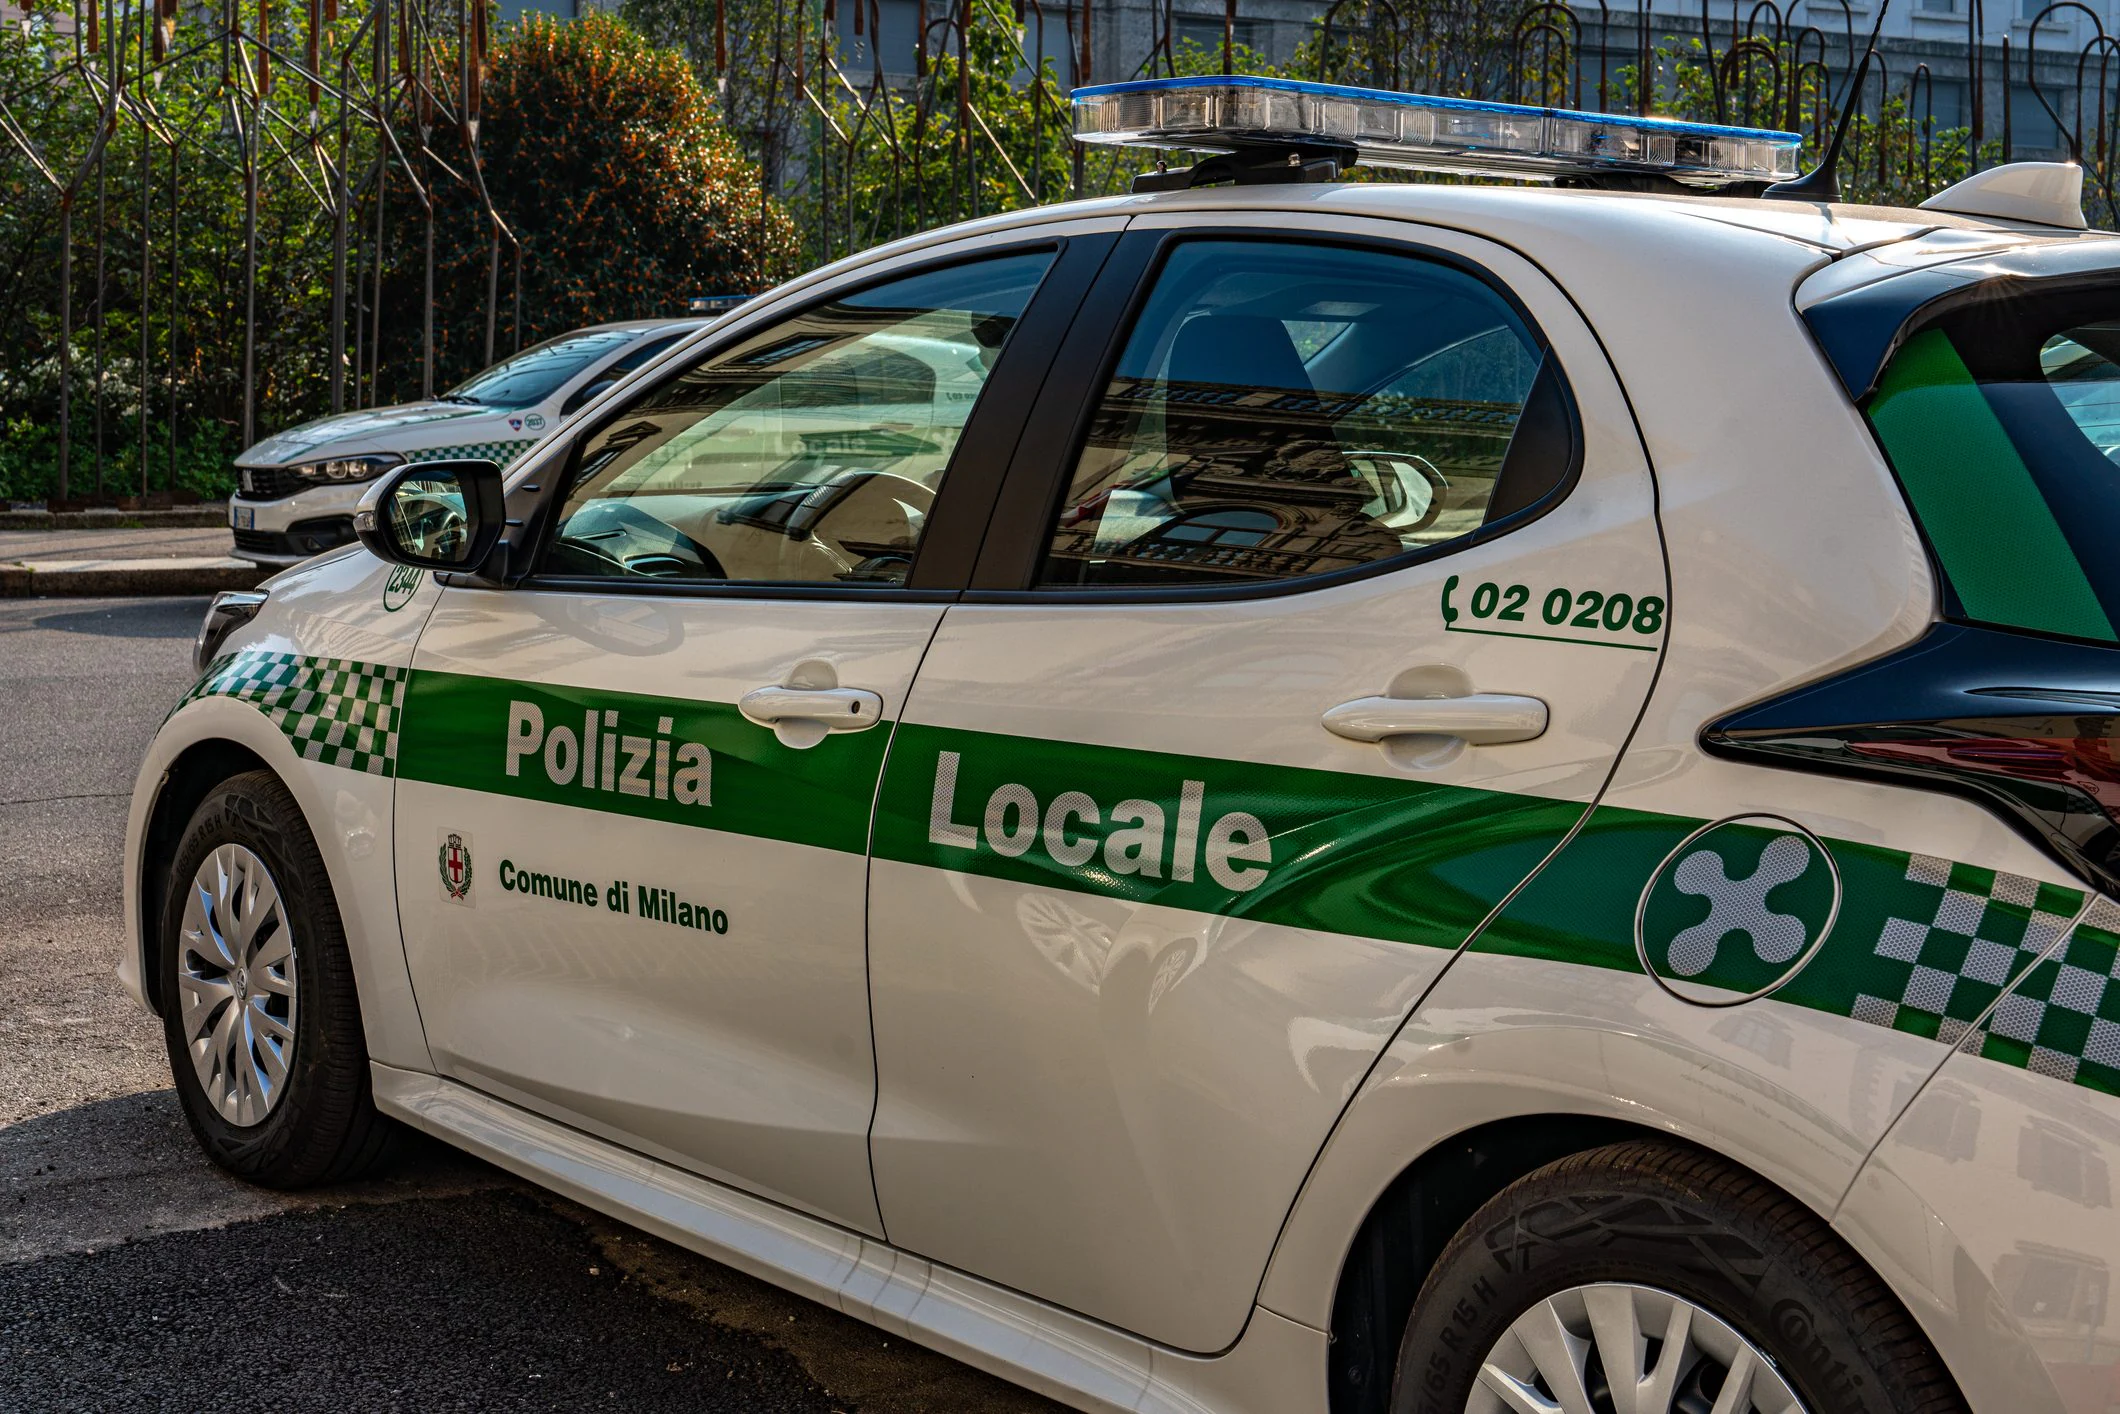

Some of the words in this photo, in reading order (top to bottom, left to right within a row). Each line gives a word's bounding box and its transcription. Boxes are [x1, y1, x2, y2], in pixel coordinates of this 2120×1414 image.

[387, 565, 421, 595] 2344
[1470, 581, 1530, 622] 02
[1542, 587, 1665, 635] 0208
[505, 700, 713, 807] Polizia
[928, 750, 1272, 892] Locale
[499, 859, 599, 908] Comune
[606, 880, 630, 915] di
[637, 885, 729, 935] Milano
